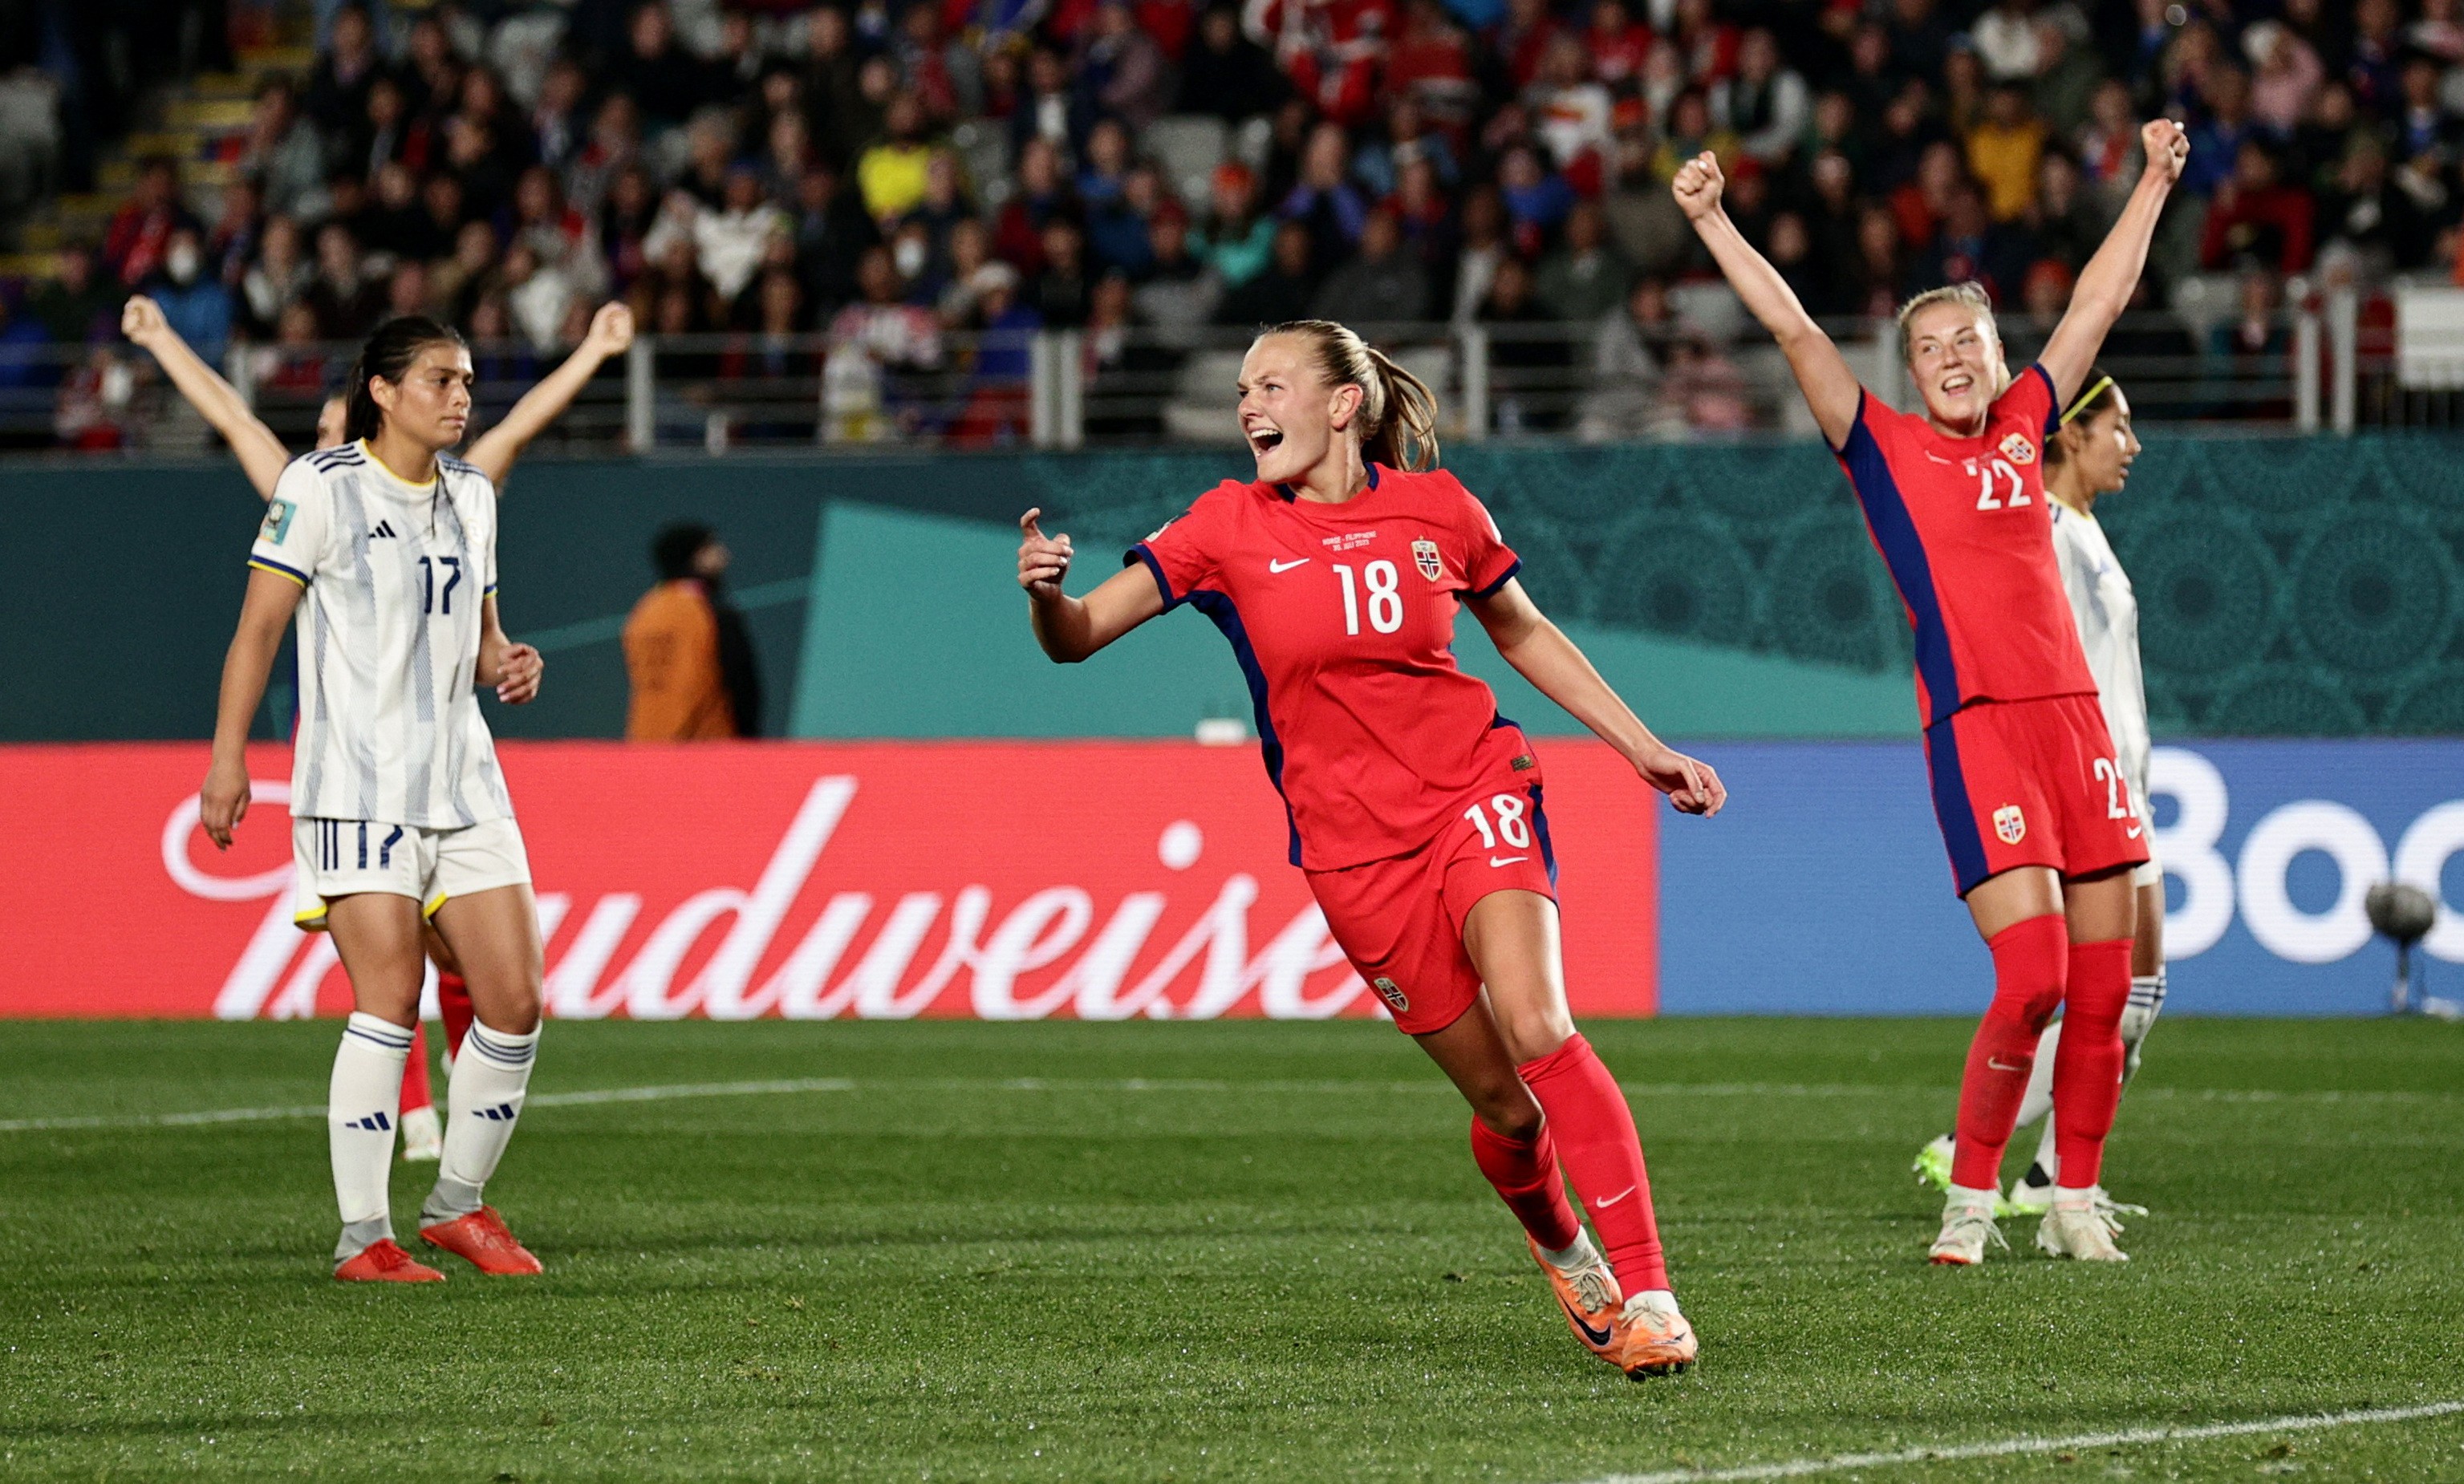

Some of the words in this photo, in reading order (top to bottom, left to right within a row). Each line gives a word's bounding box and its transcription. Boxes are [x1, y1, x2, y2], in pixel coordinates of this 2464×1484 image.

[1967, 458, 2032, 510] 22
[419, 556, 461, 614] 17
[1333, 560, 1403, 635] 18
[1463, 793, 1530, 849] 18
